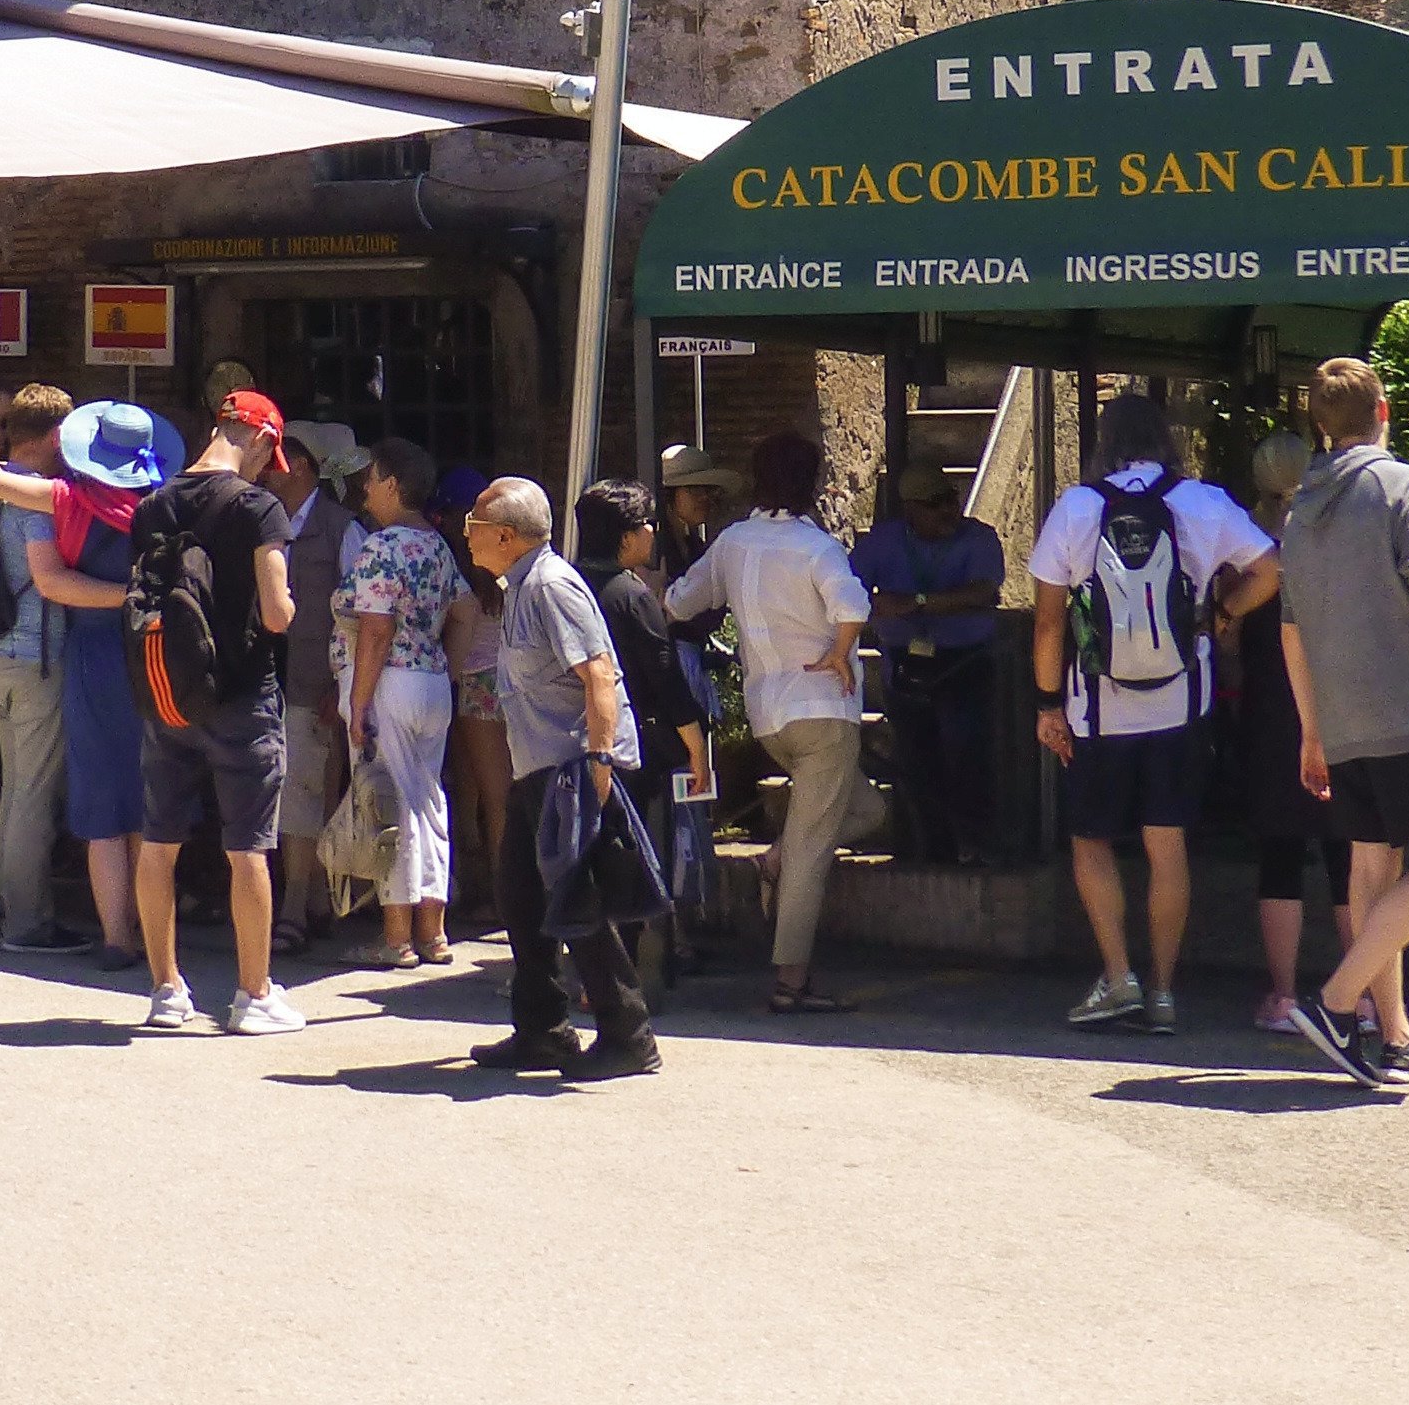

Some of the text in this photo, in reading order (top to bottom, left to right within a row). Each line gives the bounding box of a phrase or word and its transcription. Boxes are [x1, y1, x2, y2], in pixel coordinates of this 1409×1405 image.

[936, 41, 1334, 102] ENTRATA
[732, 156, 1099, 210] CATACOMBE
[1119, 150, 1240, 196] SAN
[675, 260, 842, 292] ENTRANCE
[875, 257, 1031, 287] ENTRADA
[1066, 252, 1260, 283] INGRESSUS
[660, 340, 732, 354] FRANÇAIS
